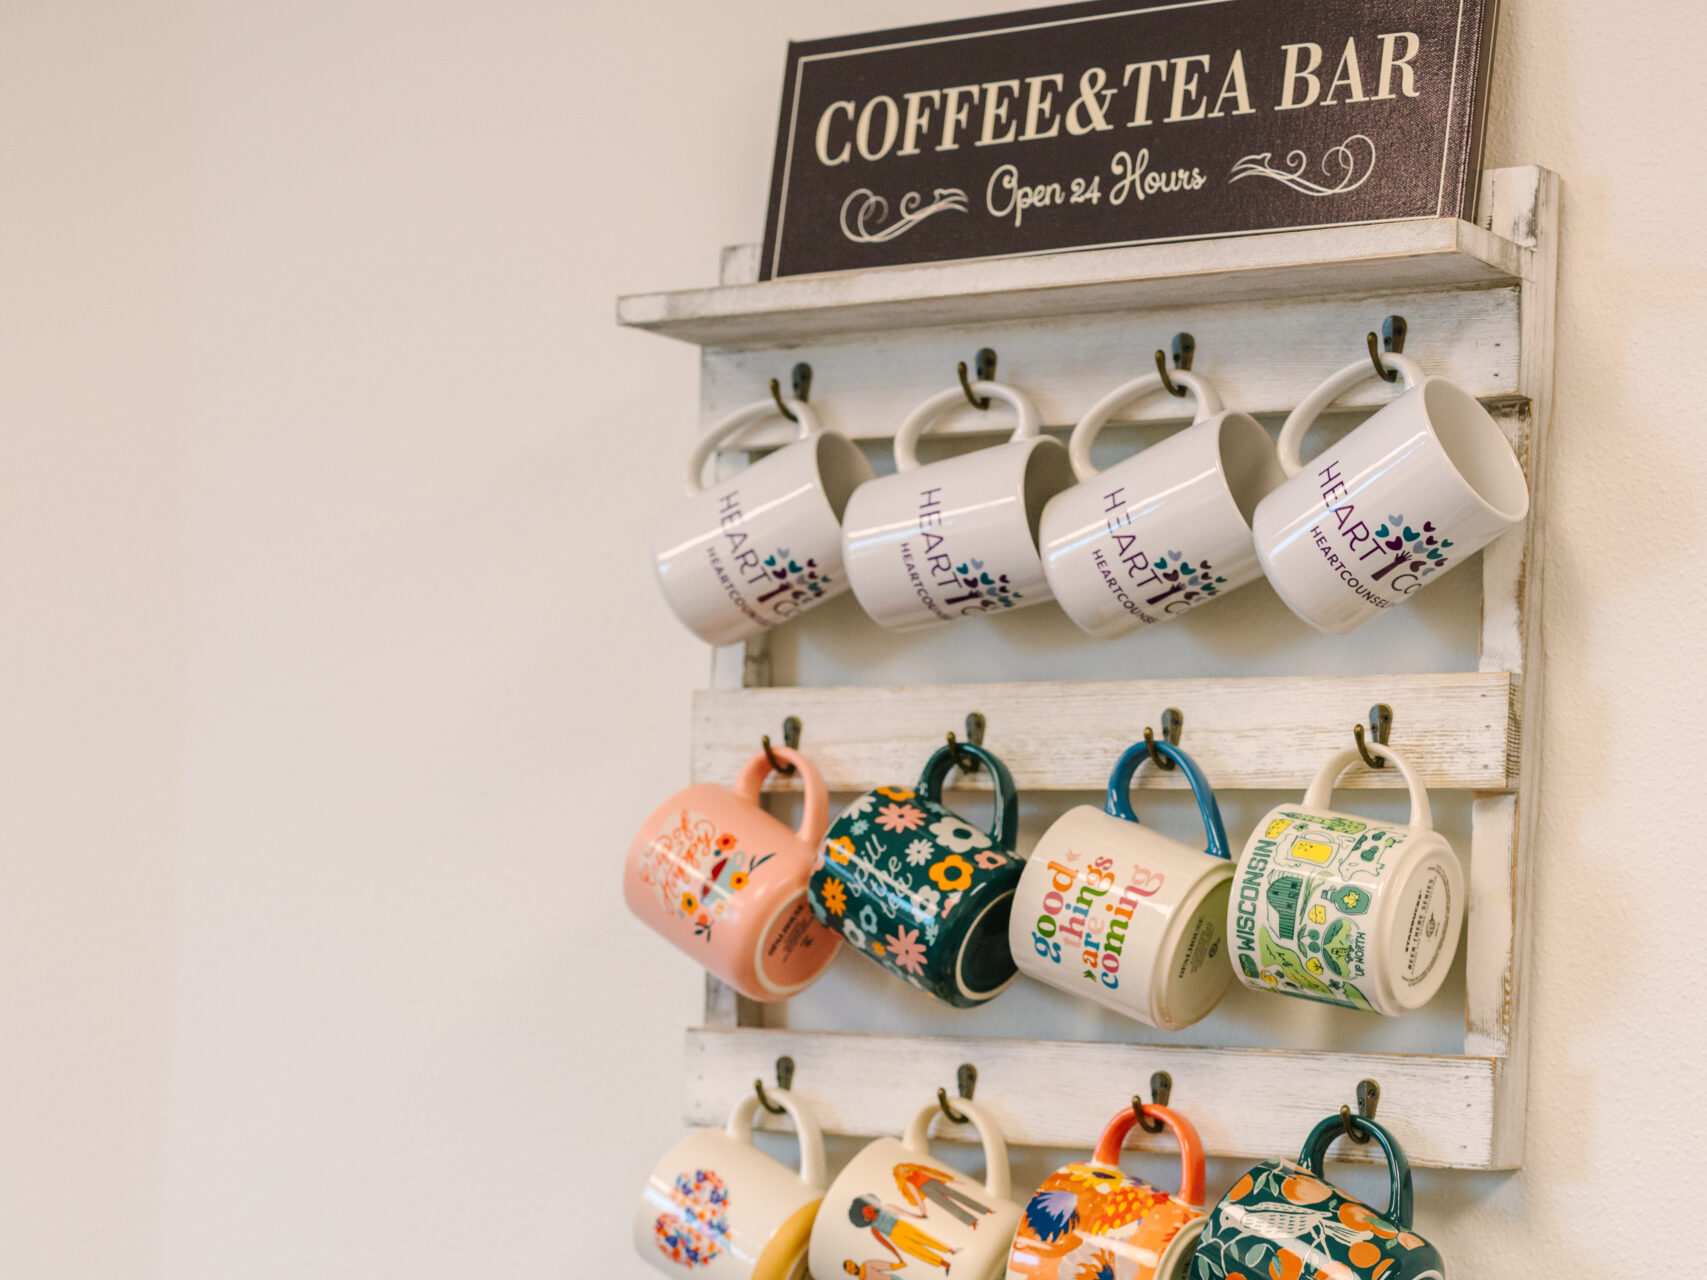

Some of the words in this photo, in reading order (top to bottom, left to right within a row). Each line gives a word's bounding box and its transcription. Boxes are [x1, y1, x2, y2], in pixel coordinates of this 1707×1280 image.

[1274, 31, 1421, 111] BAR
[986, 164, 1066, 228] Open
[1069, 175, 1102, 206] 24
[1109, 147, 1207, 206] Hours
[718, 490, 772, 584] HEART
[919, 487, 963, 589] HEART
[1103, 487, 1164, 588] HEART
[1317, 460, 1387, 561] HEART
[846, 833, 888, 899] spill
[869, 856, 903, 897] the
[879, 872, 913, 919] tea
[1058, 856, 1116, 949] things
[1235, 839, 1277, 952] WISCONSIN
[1031, 861, 1080, 964] good
[1081, 916, 1106, 969] are
[1100, 863, 1166, 990] coming
[1354, 931, 1367, 961] NORTH
[1354, 962, 1366, 977] UP
